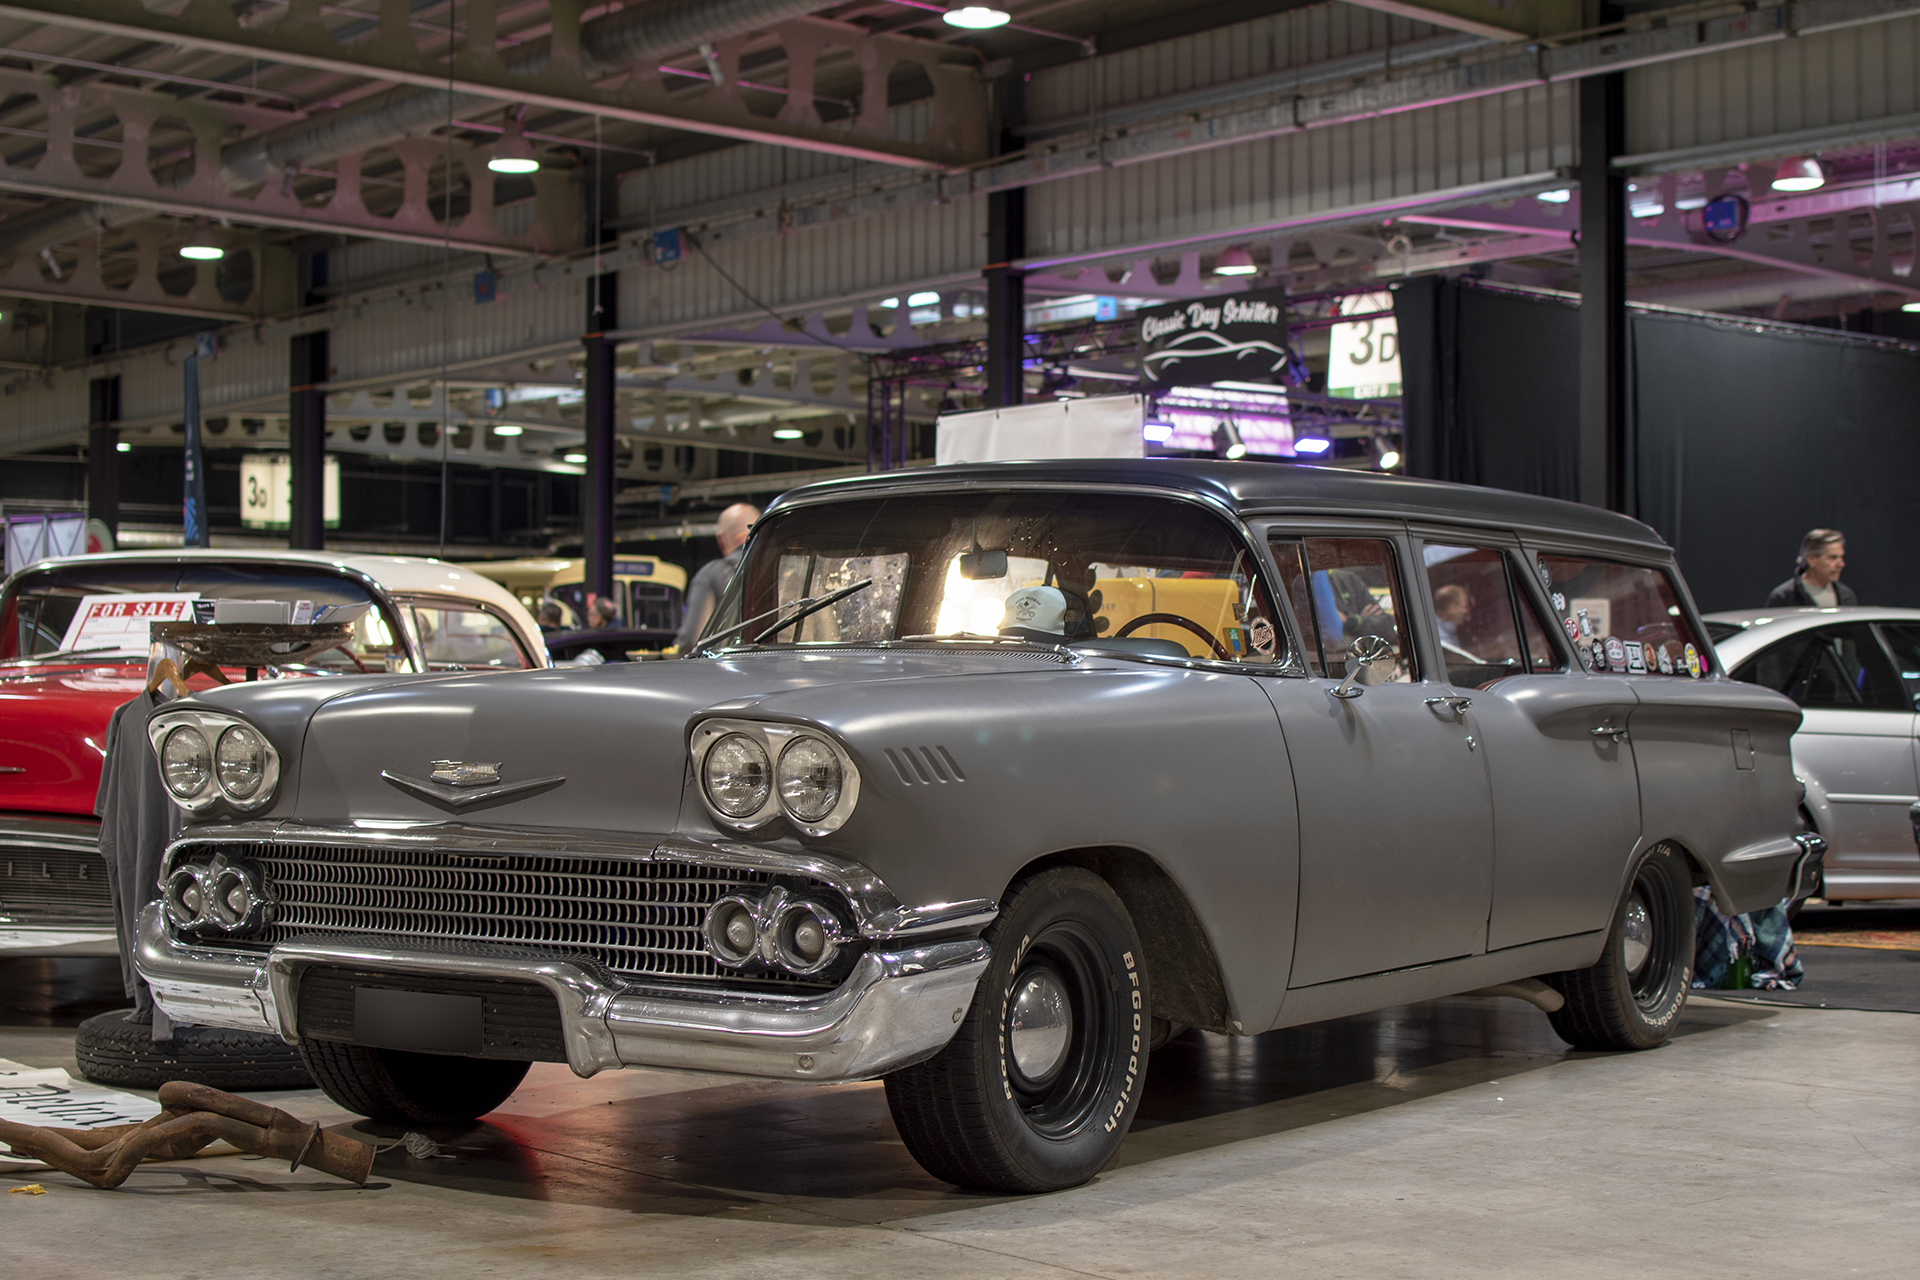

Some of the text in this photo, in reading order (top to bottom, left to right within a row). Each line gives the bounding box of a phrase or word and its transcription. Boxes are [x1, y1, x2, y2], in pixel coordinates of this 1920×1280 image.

[1142, 310, 1186, 342] Classic
[1187, 302, 1221, 331] Day
[1350, 320, 1400, 365] 3D
[248, 476, 267, 508] 3D
[89, 604, 125, 617] FOR
[133, 602, 183, 616] SALE
[1657, 844, 1671, 857] T/A
[1009, 935, 1030, 975] T/A
[1641, 965, 1691, 1029] BFGoodrich
[998, 987, 1012, 1100] Radial
[1104, 951, 1142, 1133] BFGoodrich
